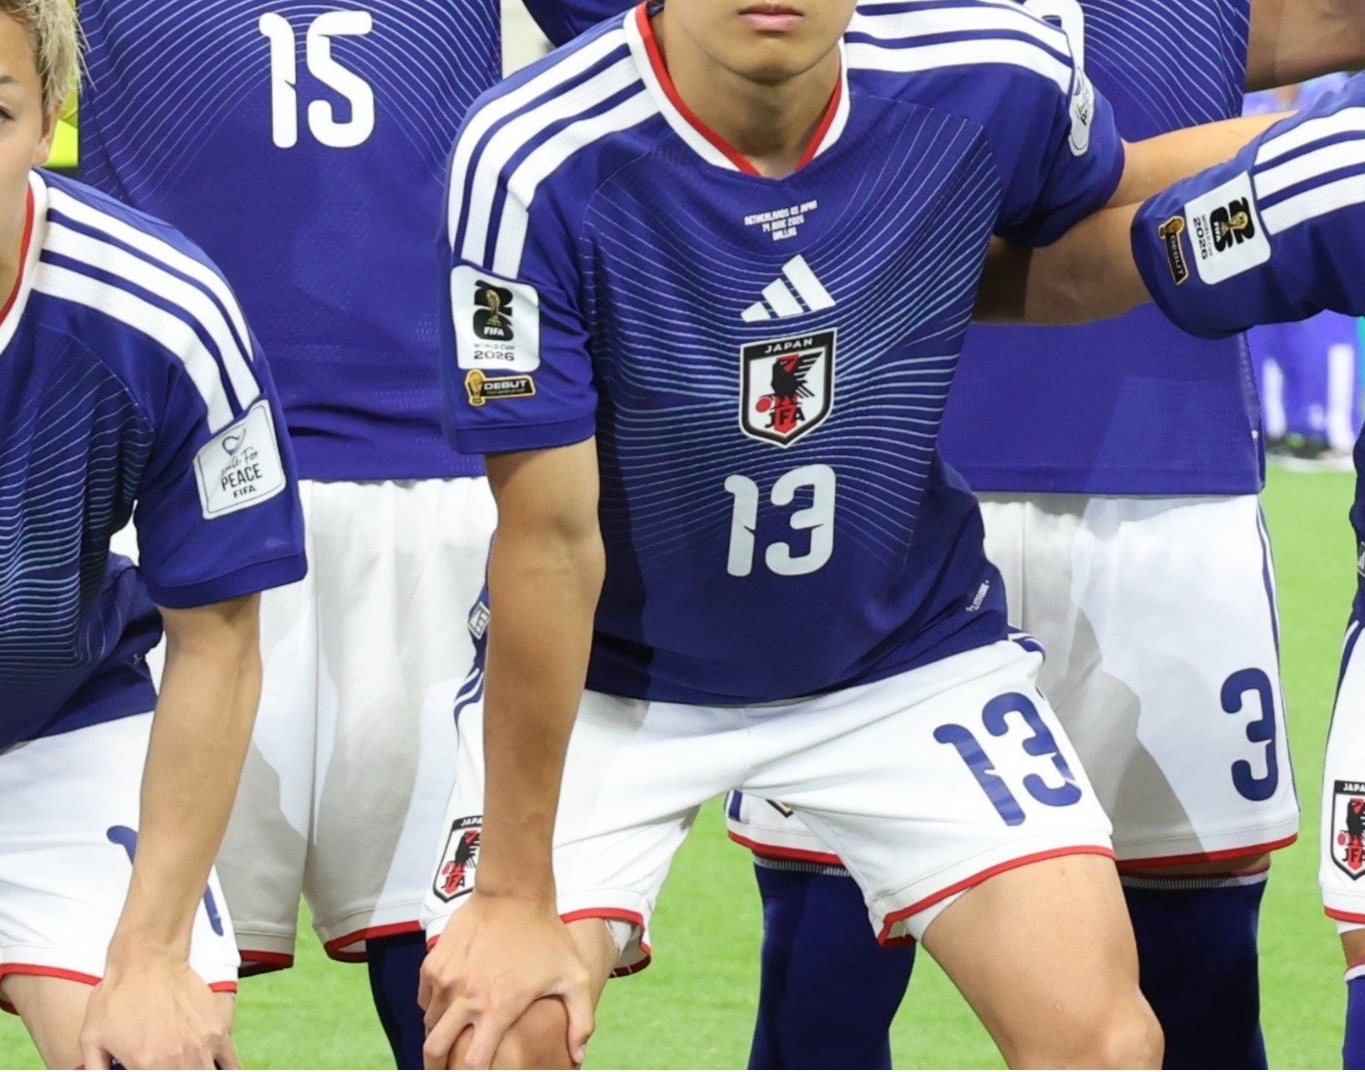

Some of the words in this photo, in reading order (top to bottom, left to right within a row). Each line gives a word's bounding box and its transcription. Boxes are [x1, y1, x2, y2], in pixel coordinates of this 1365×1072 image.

[259, 10, 375, 149] 15
[1193, 217, 1208, 260] 2026
[484, 327, 505, 337] FIFA
[474, 350, 515, 361] 2026
[764, 338, 813, 354] JAPAN
[484, 380, 527, 391] DEBUT
[765, 407, 806, 429] JFA
[221, 463, 262, 491] PEACE
[233, 485, 256, 498] FIFA
[724, 464, 836, 576] 13
[1221, 667, 1278, 801] 3
[933, 692, 1082, 826] 13
[460, 816, 483, 827] JAPA
